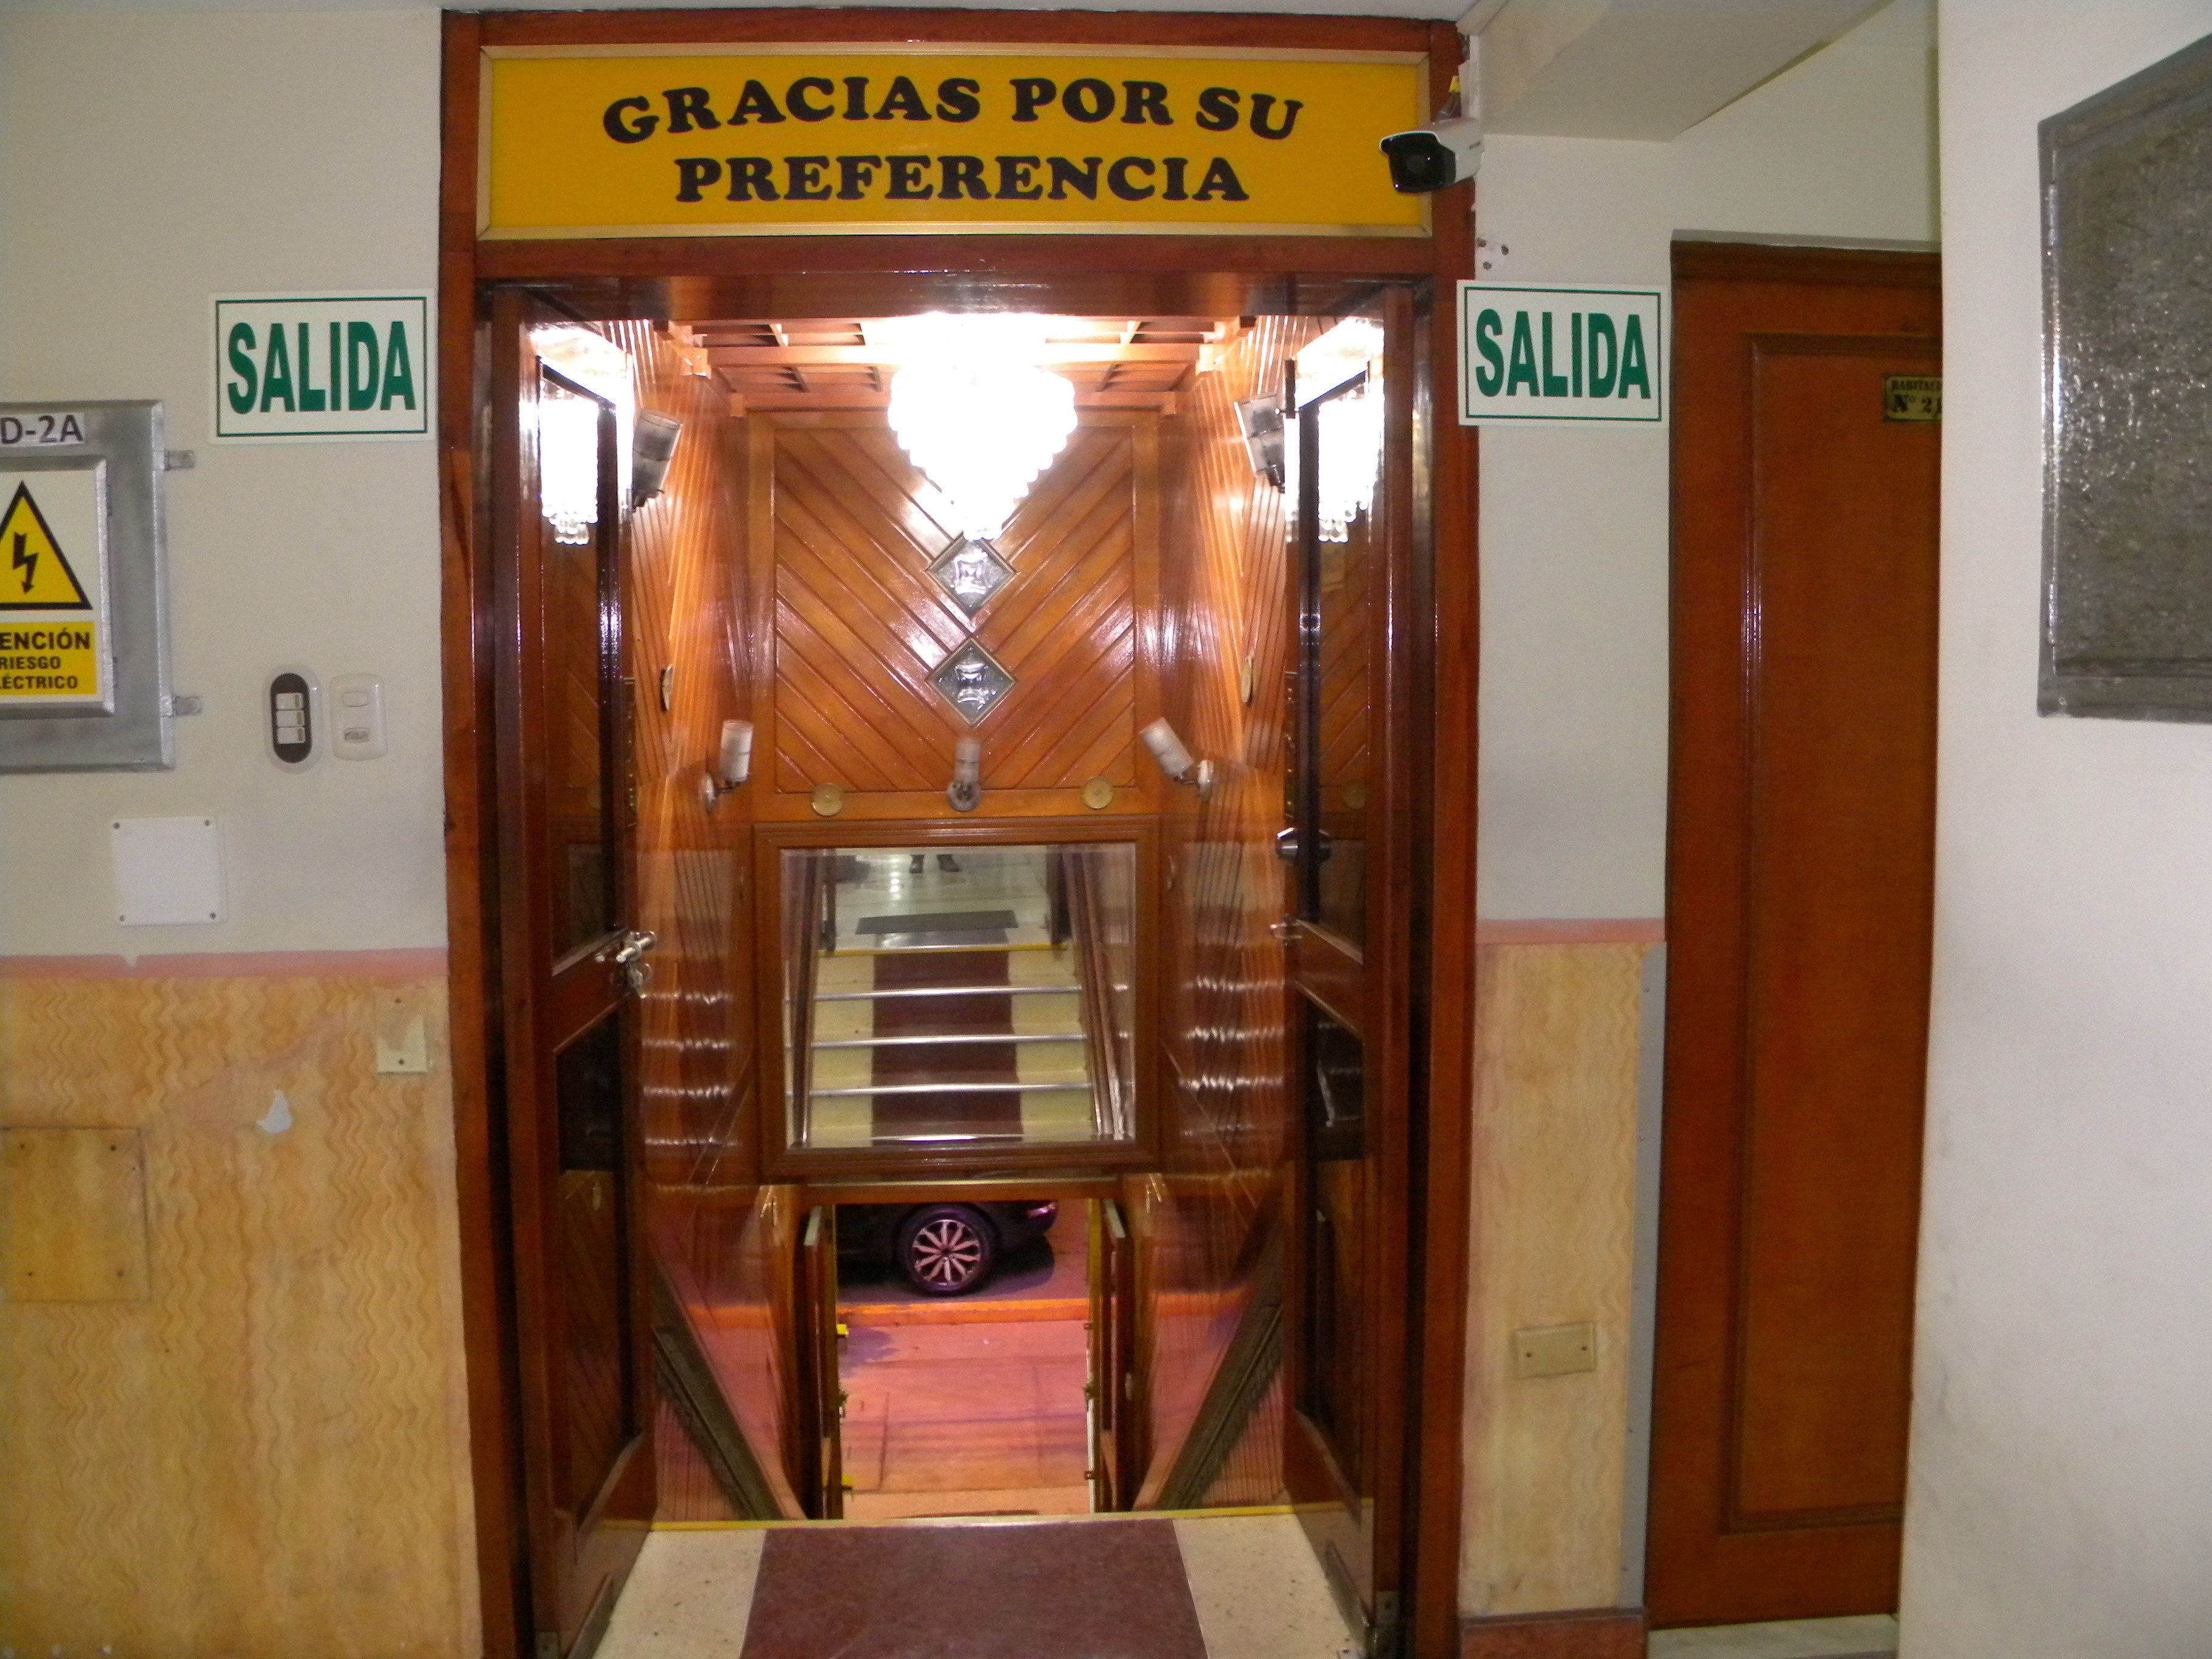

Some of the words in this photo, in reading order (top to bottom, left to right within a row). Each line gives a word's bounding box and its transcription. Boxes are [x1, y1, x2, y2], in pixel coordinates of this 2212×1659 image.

[603, 76, 980, 144] GRACIAS
[1009, 78, 1173, 126] POR
[1195, 87, 1303, 140] SU
[674, 155, 1250, 202] PREFERENCIA
[227, 321, 417, 415] SALIDA
[1475, 309, 1651, 399] SALIDA
[0, 415, 84, 444] D-2A
[0, 627, 90, 649] ENCIÓN
[0, 673, 78, 689] ÉCTRICO
